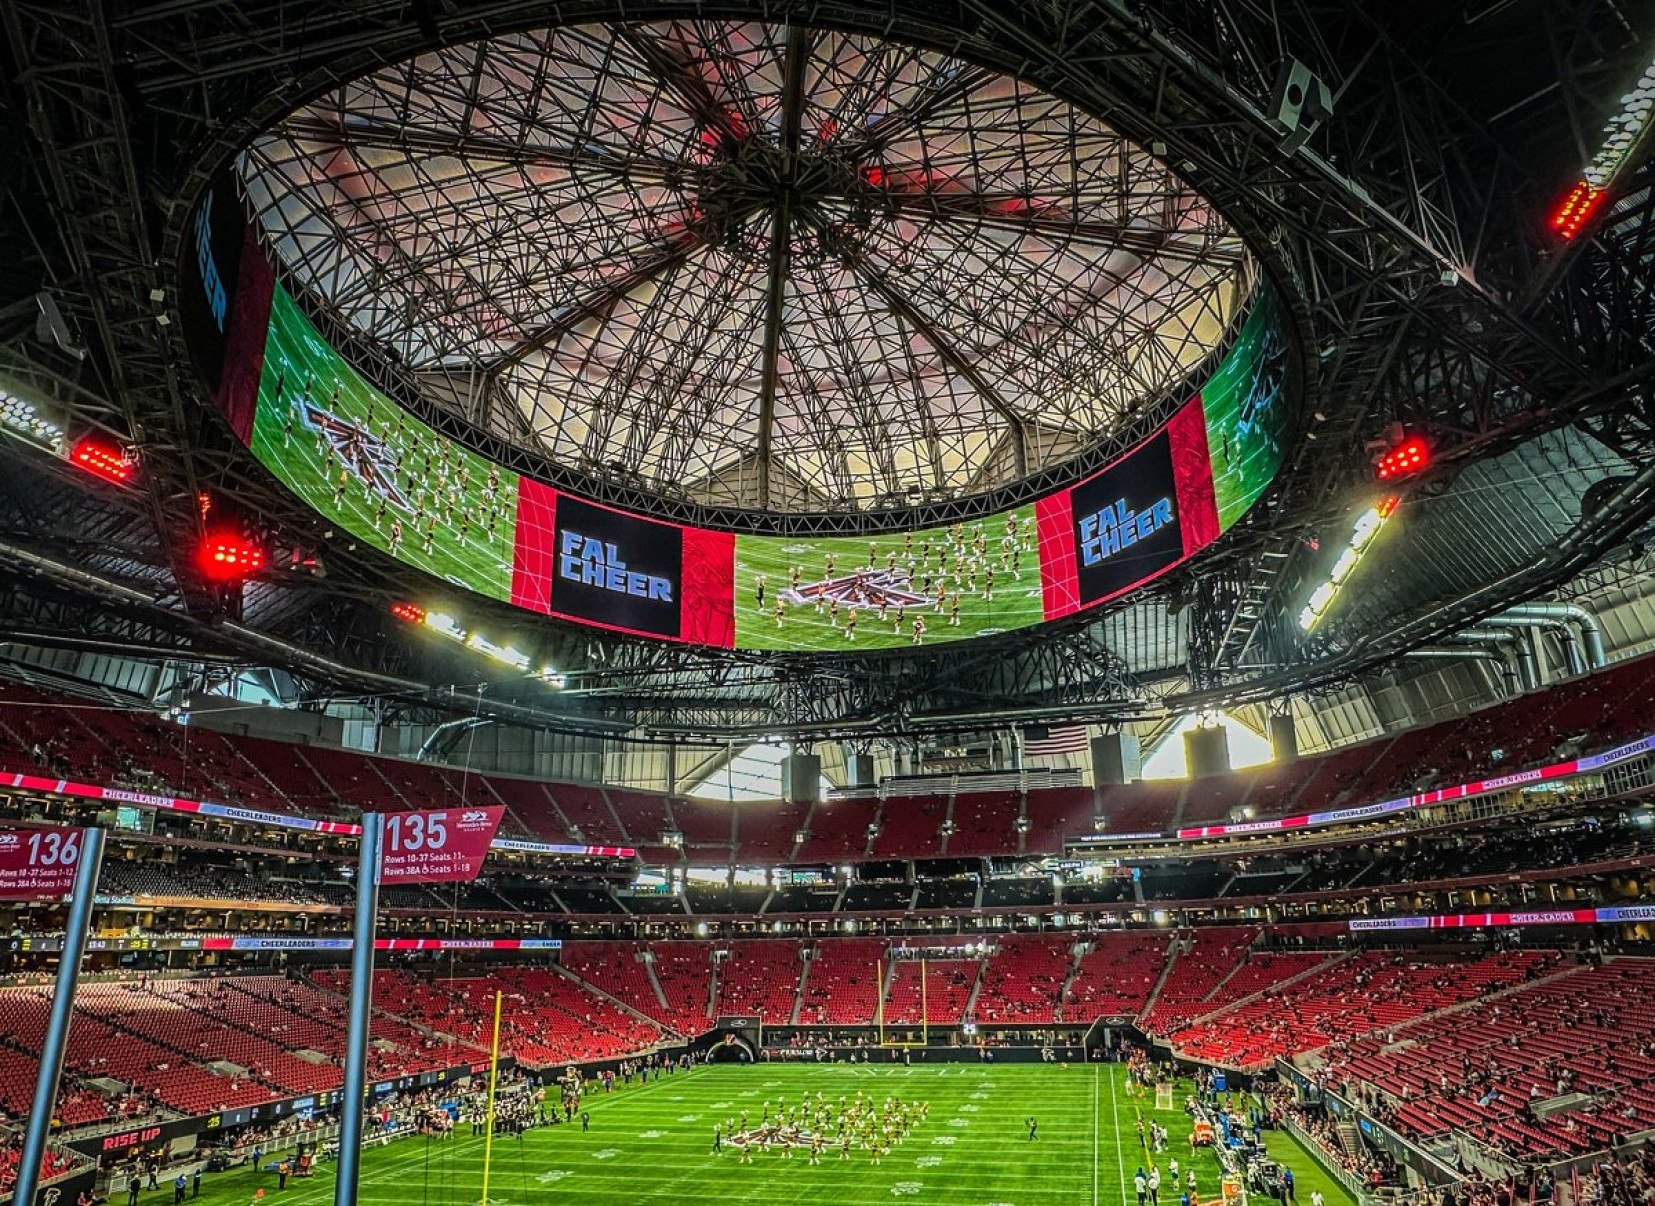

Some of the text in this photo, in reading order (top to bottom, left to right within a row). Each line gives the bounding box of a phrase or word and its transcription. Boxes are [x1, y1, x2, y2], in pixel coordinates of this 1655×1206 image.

[1079, 498, 1136, 543] FAL
[1081, 497, 1174, 567] CHEER
[561, 529, 627, 570] FAL
[560, 553, 673, 602] CHEER
[1603, 739, 1650, 763] CHEERLEADERS
[101, 787, 175, 807] CHEERLEADERS
[226, 808, 283, 824] CHEERLEADERS
[386, 812, 447, 851] 135
[28, 831, 78, 865] 136
[384, 855, 405, 864] Rows
[430, 853, 451, 862] Seats
[384, 867, 405, 876] Rows
[430, 864, 451, 874] Seats
[261, 939, 316, 948] CHEERLEADERS
[103, 1128, 161, 1150] RISE UP
